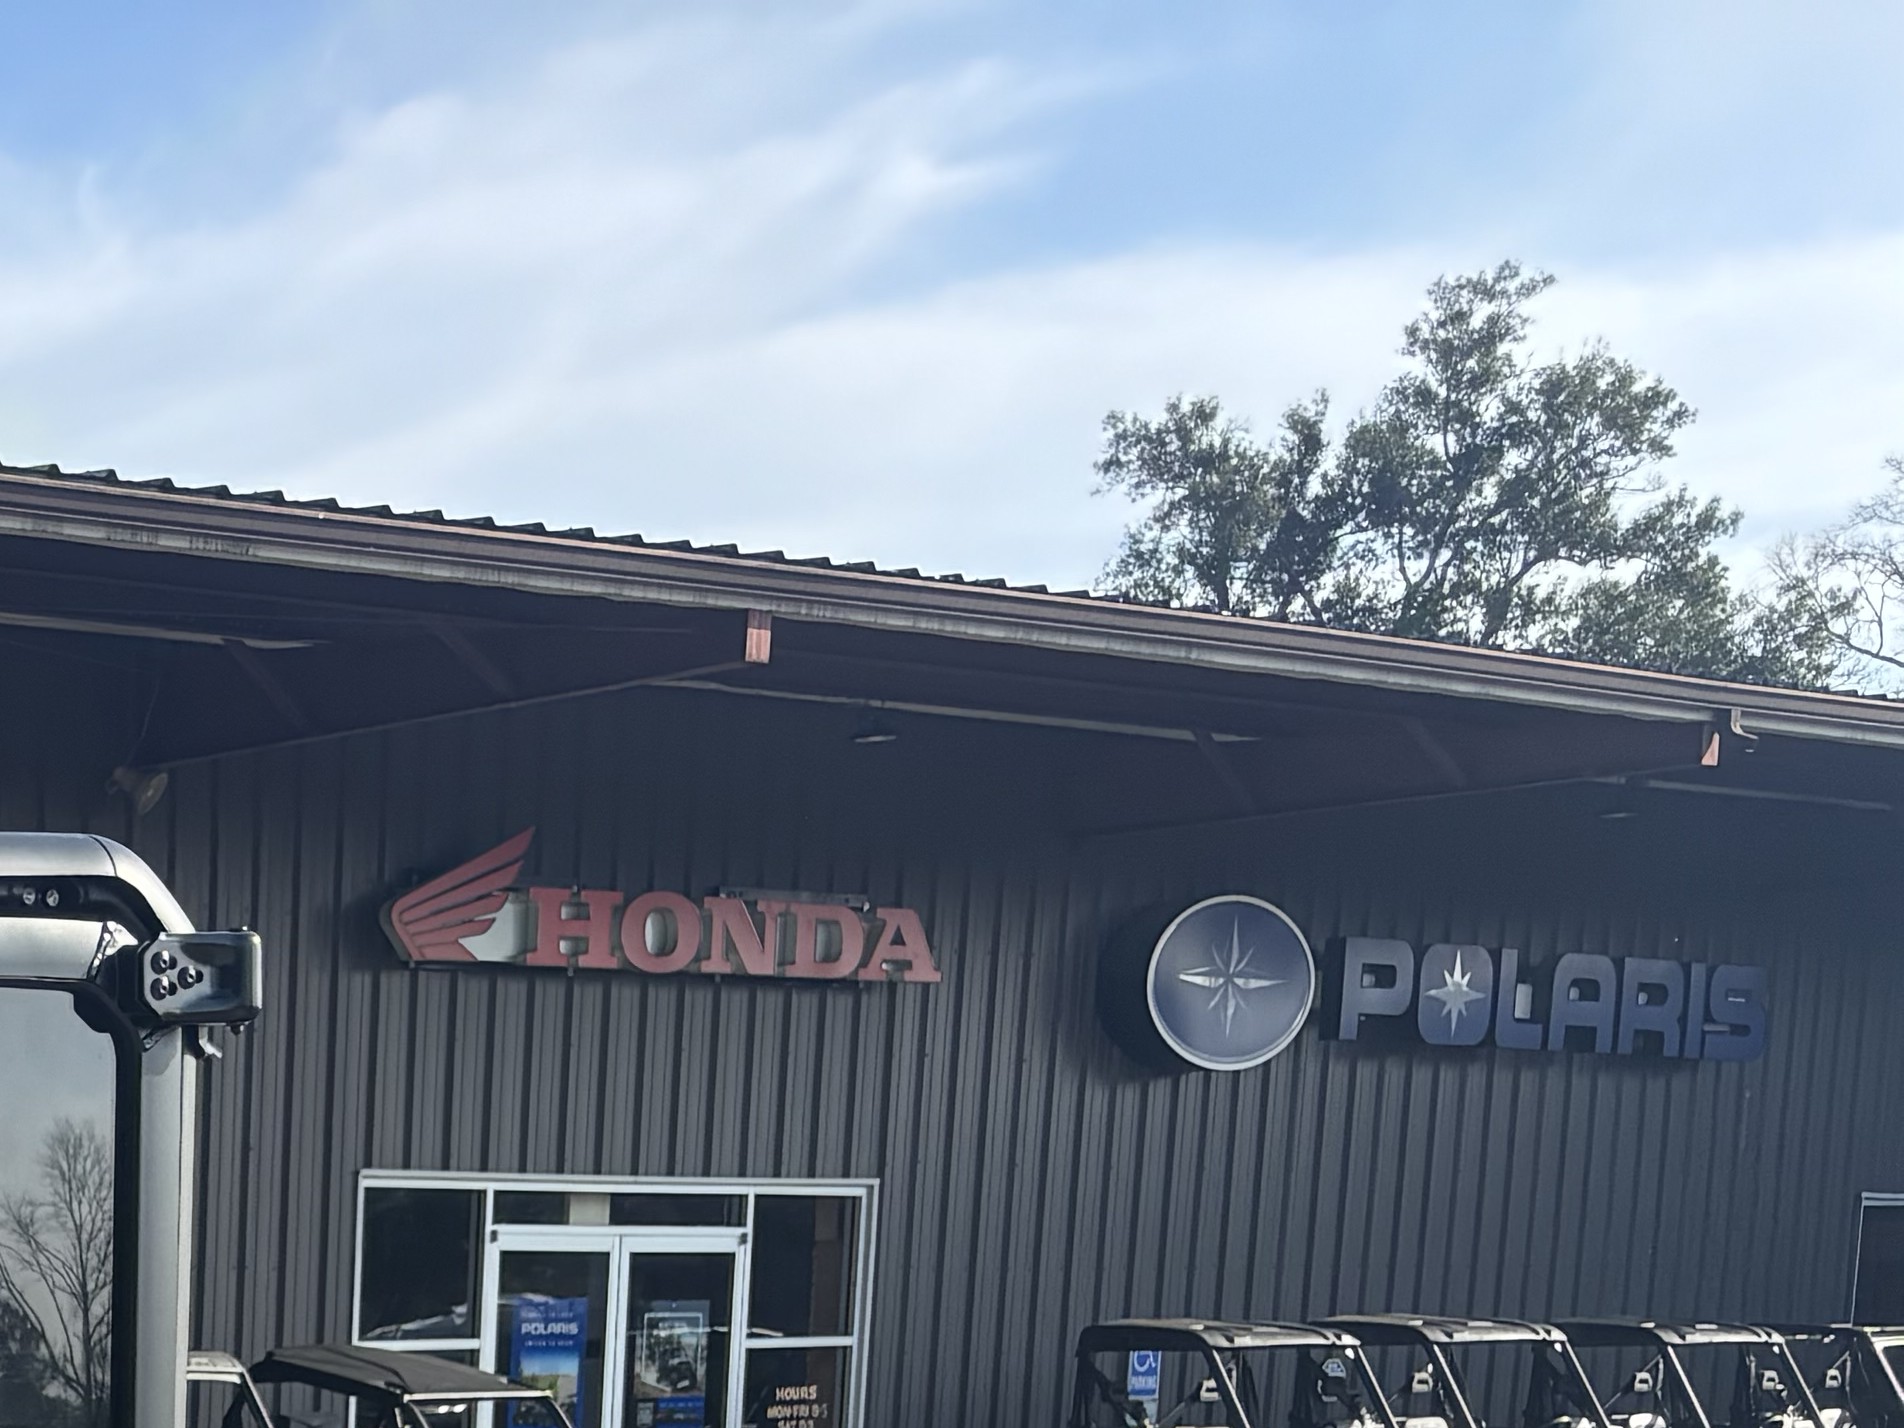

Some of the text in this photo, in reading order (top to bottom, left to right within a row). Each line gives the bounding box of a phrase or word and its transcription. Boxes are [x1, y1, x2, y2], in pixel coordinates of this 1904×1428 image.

[525, 886, 942, 983] HONDA
[1338, 937, 1768, 1061] POLARIS
[521, 1322, 579, 1335] POLARIS
[776, 1385, 817, 1401] HOURS
